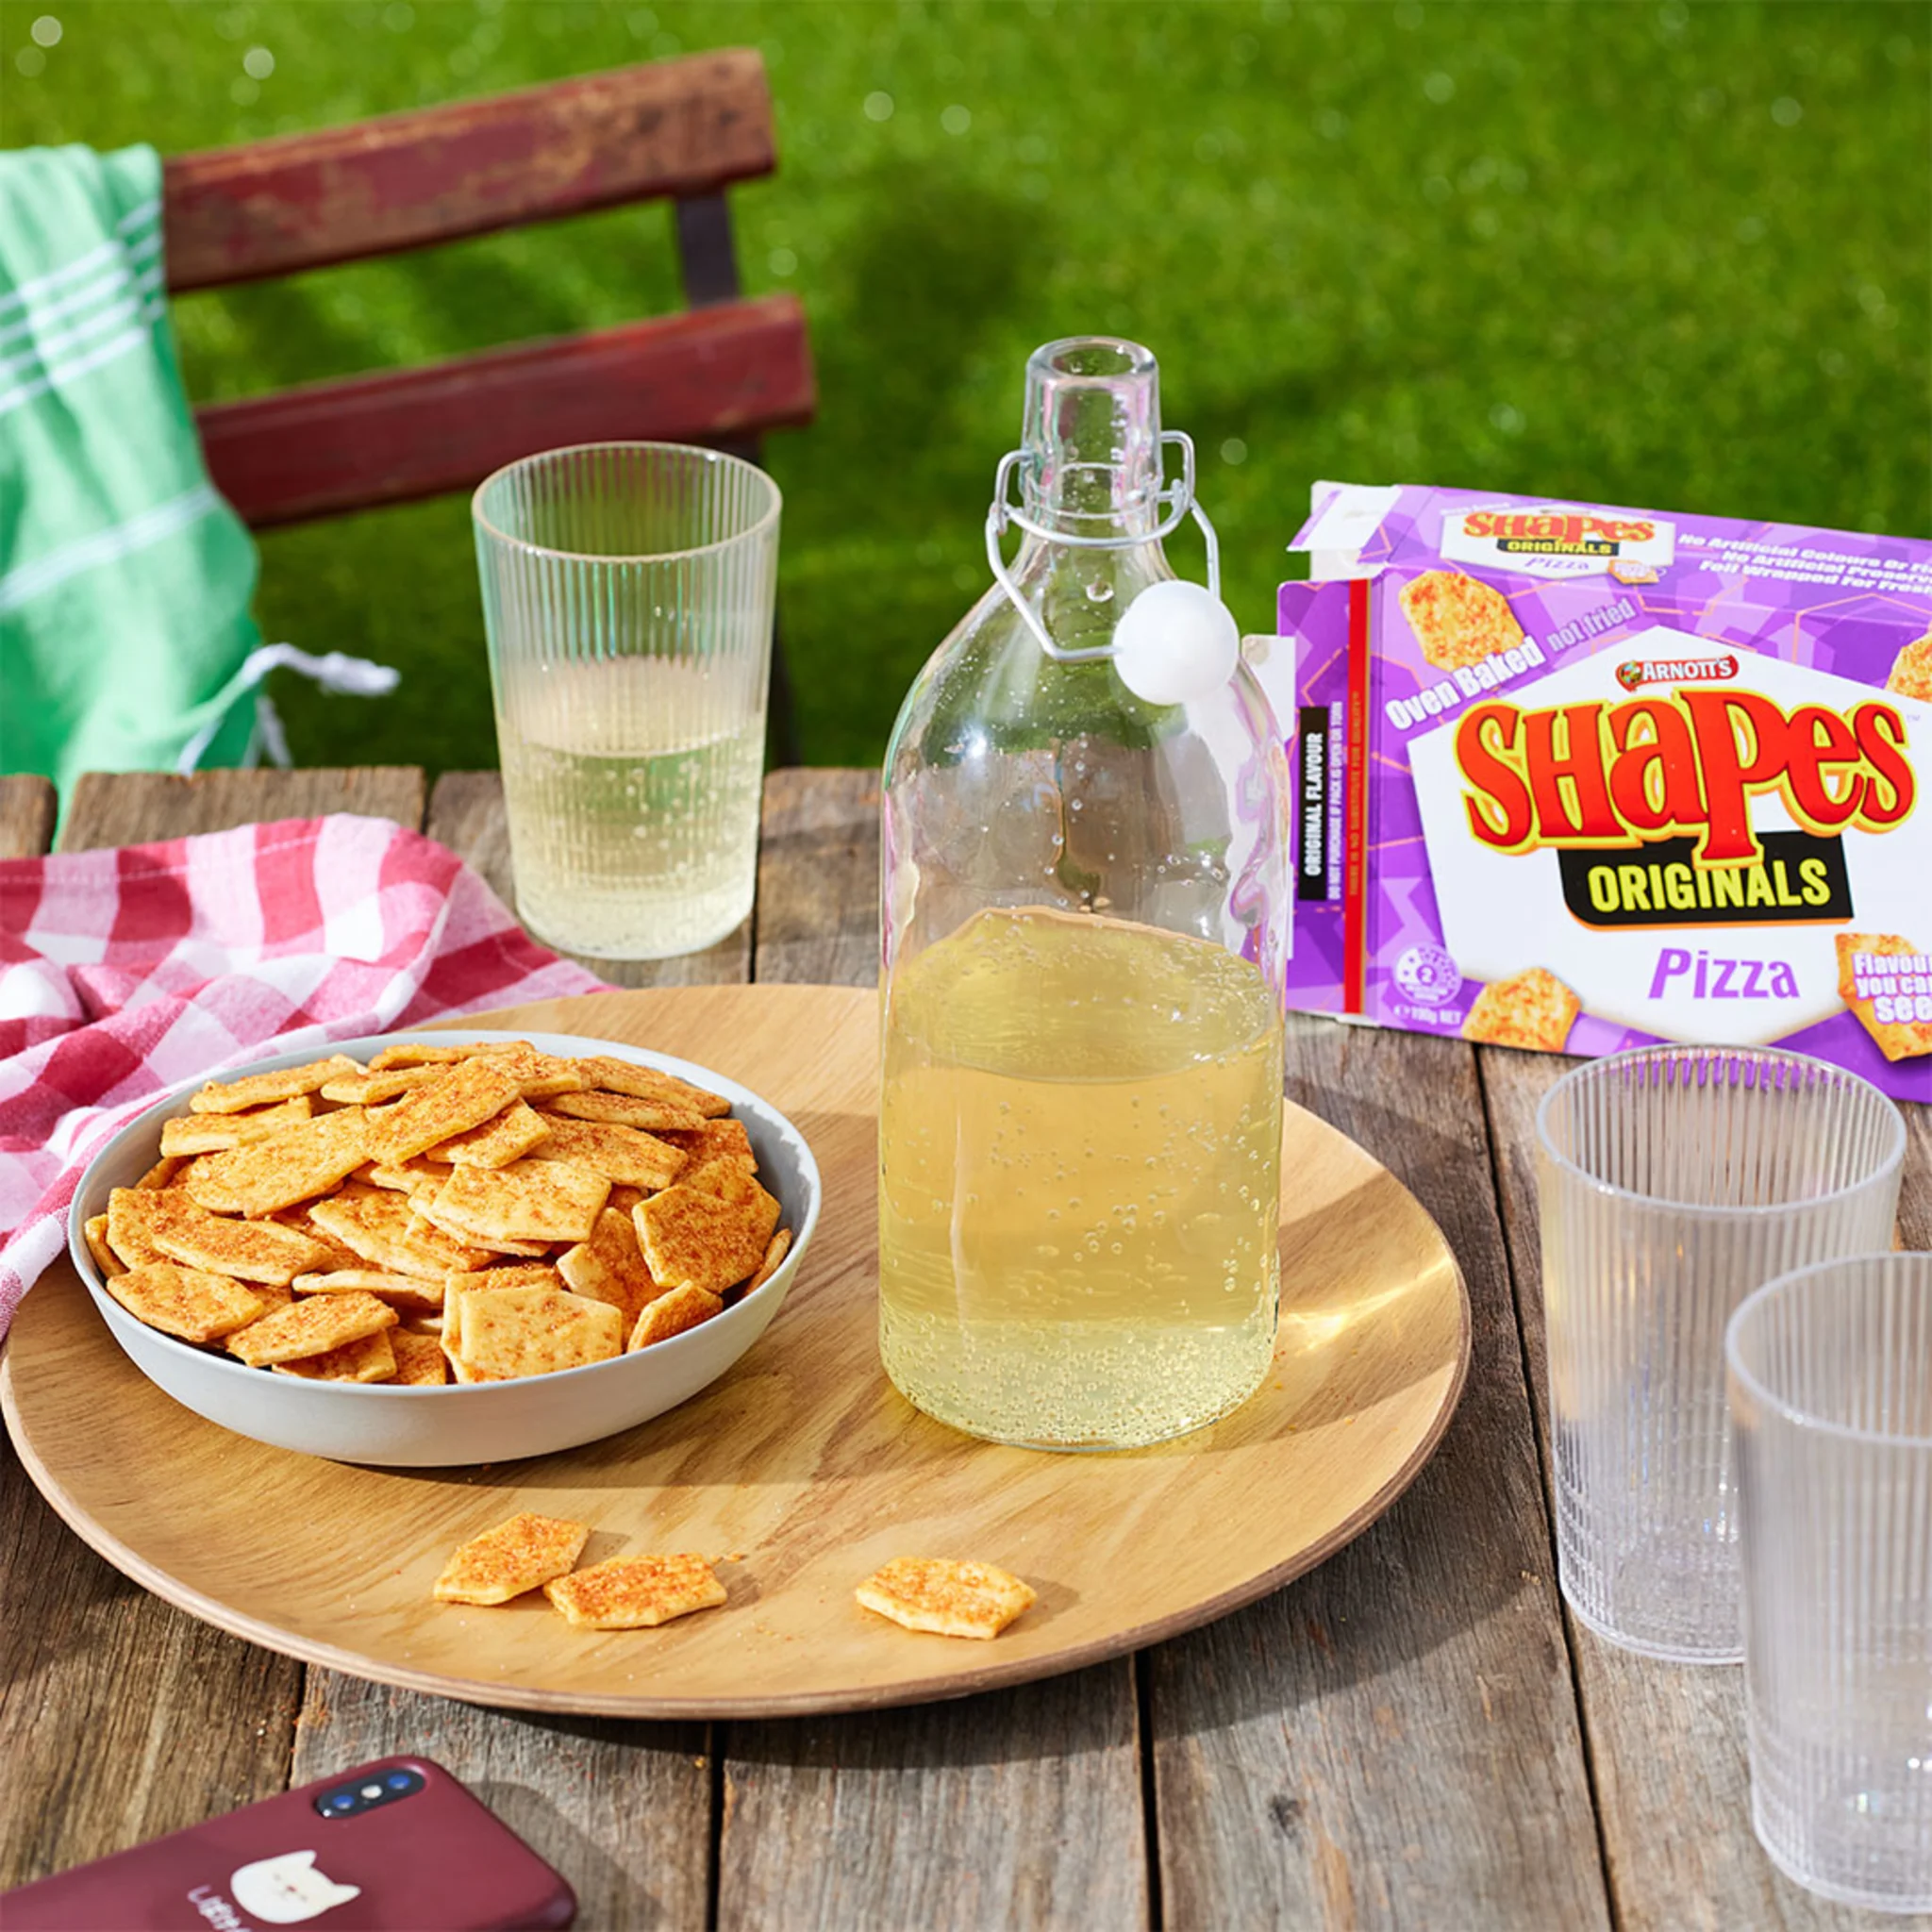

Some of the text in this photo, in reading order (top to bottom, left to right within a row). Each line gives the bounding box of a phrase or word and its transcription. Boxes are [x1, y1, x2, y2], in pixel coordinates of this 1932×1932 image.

[1507, 540, 1612, 555] ORIGINALS
[1524, 557, 1589, 570] Pizza
[1678, 534, 1706, 546] No
[1708, 537, 1796, 557] Artificial
[1801, 544, 1880, 566] Colours
[1884, 558, 1908, 570] Or
[1722, 551, 1749, 563] No
[1752, 554, 1843, 574] Artificial
[1699, 559, 1740, 574] Foil
[1742, 564, 1839, 586] Wrapped
[1840, 574, 1876, 588] For
[1385, 597, 1637, 730] Oven Baked not fried
[1304, 732, 1323, 876] ORIGINAL FLAVOUR
[1588, 858, 1832, 912] ORIGINALS
[1648, 947, 1800, 1000] Pizza
[1855, 976, 1897, 1000] you
